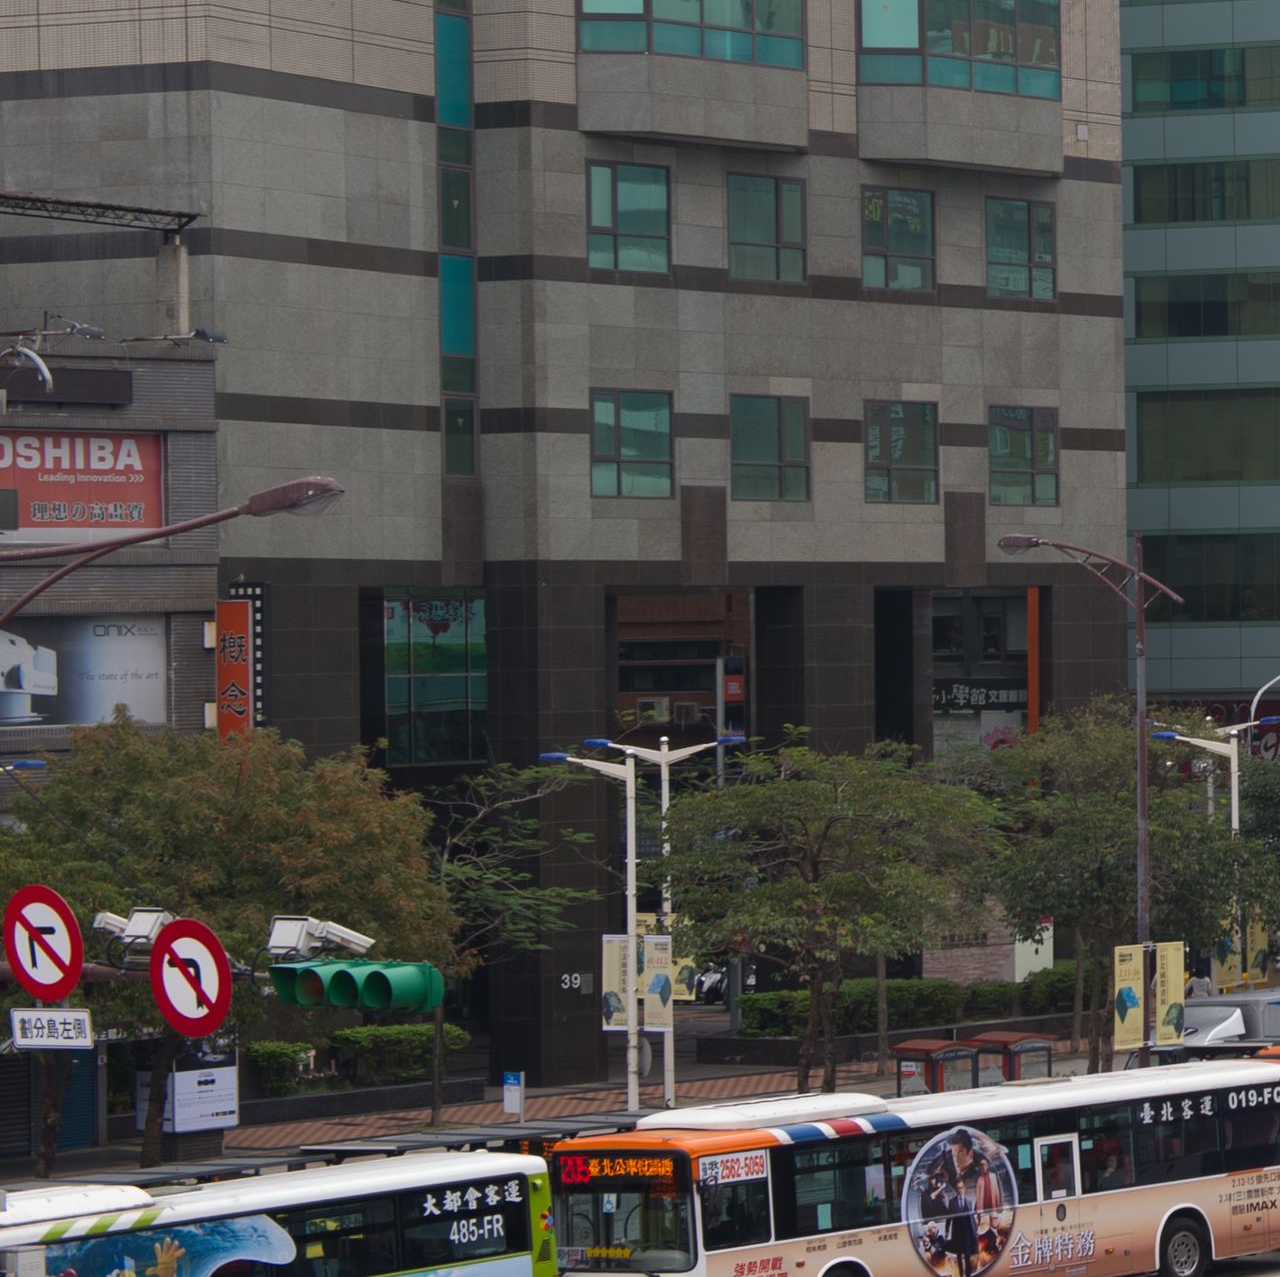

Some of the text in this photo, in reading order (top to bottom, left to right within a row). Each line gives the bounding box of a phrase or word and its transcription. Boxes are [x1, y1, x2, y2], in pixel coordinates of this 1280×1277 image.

[38, 473, 127, 484] Leading Innovation
[561, 973, 582, 989] 39
[19, 1017, 88, 1040] 劃分島左側
[1140, 1095, 1215, 1124] 臺北客運
[422, 1179, 524, 1217] 大都會客運
[450, 1214, 505, 1244] 485-FR
[1008, 1228, 1096, 1269] 金牌特務
